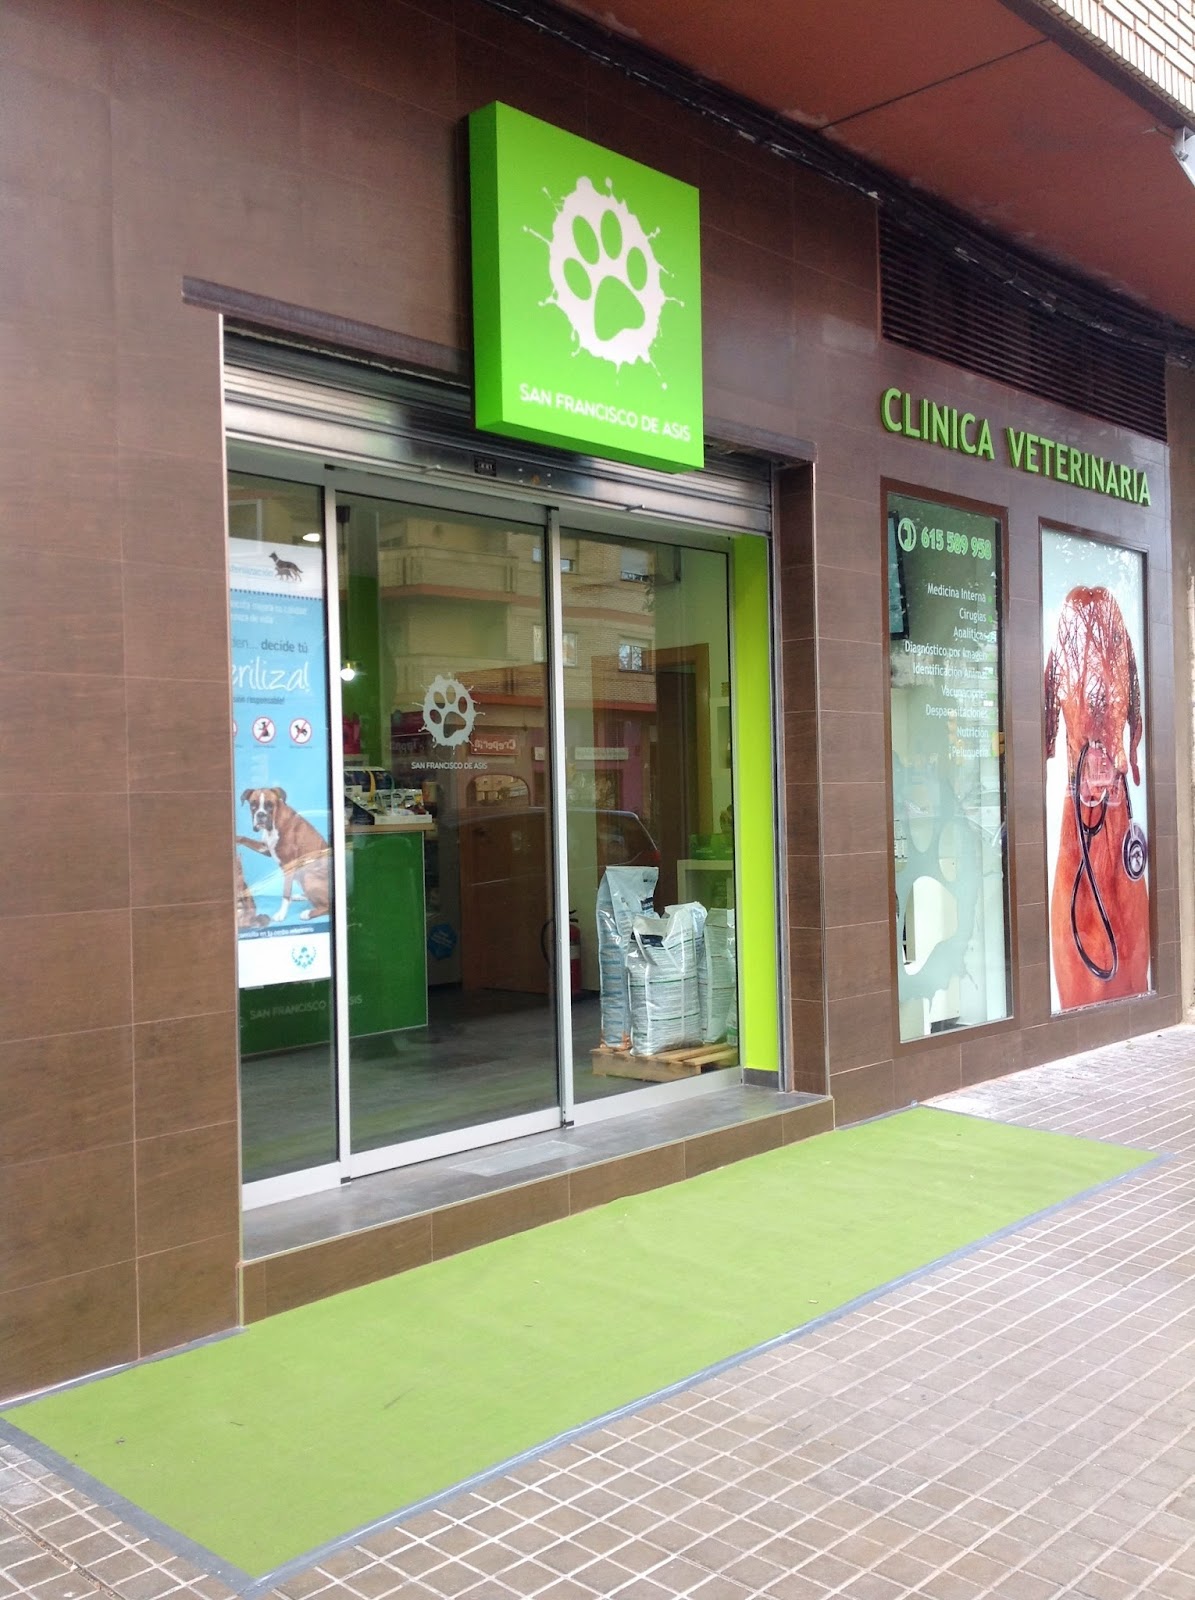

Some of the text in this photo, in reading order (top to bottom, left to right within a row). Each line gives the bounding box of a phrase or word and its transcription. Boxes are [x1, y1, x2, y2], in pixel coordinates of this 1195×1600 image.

[519, 383, 691, 442] SAN FRANCISCO DE ASIS
[880, 387, 1151, 506] CLINICA VETERINARIA
[921, 526, 992, 560] 615 589 958
[927, 582, 986, 603] Medicina Interna
[260, 639, 295, 653] decide
[904, 640, 946, 656] Diagnóstico
[947, 648, 961, 660] por
[912, 662, 963, 677] Identificación
[941, 685, 988, 699] Vacunaciones
[925, 703, 989, 719] Desparasitaciones
[411, 761, 488, 770] SAN FRANCISCO DE ASIS
[249, 994, 363, 1020] SAN FRANCISCO SIS
